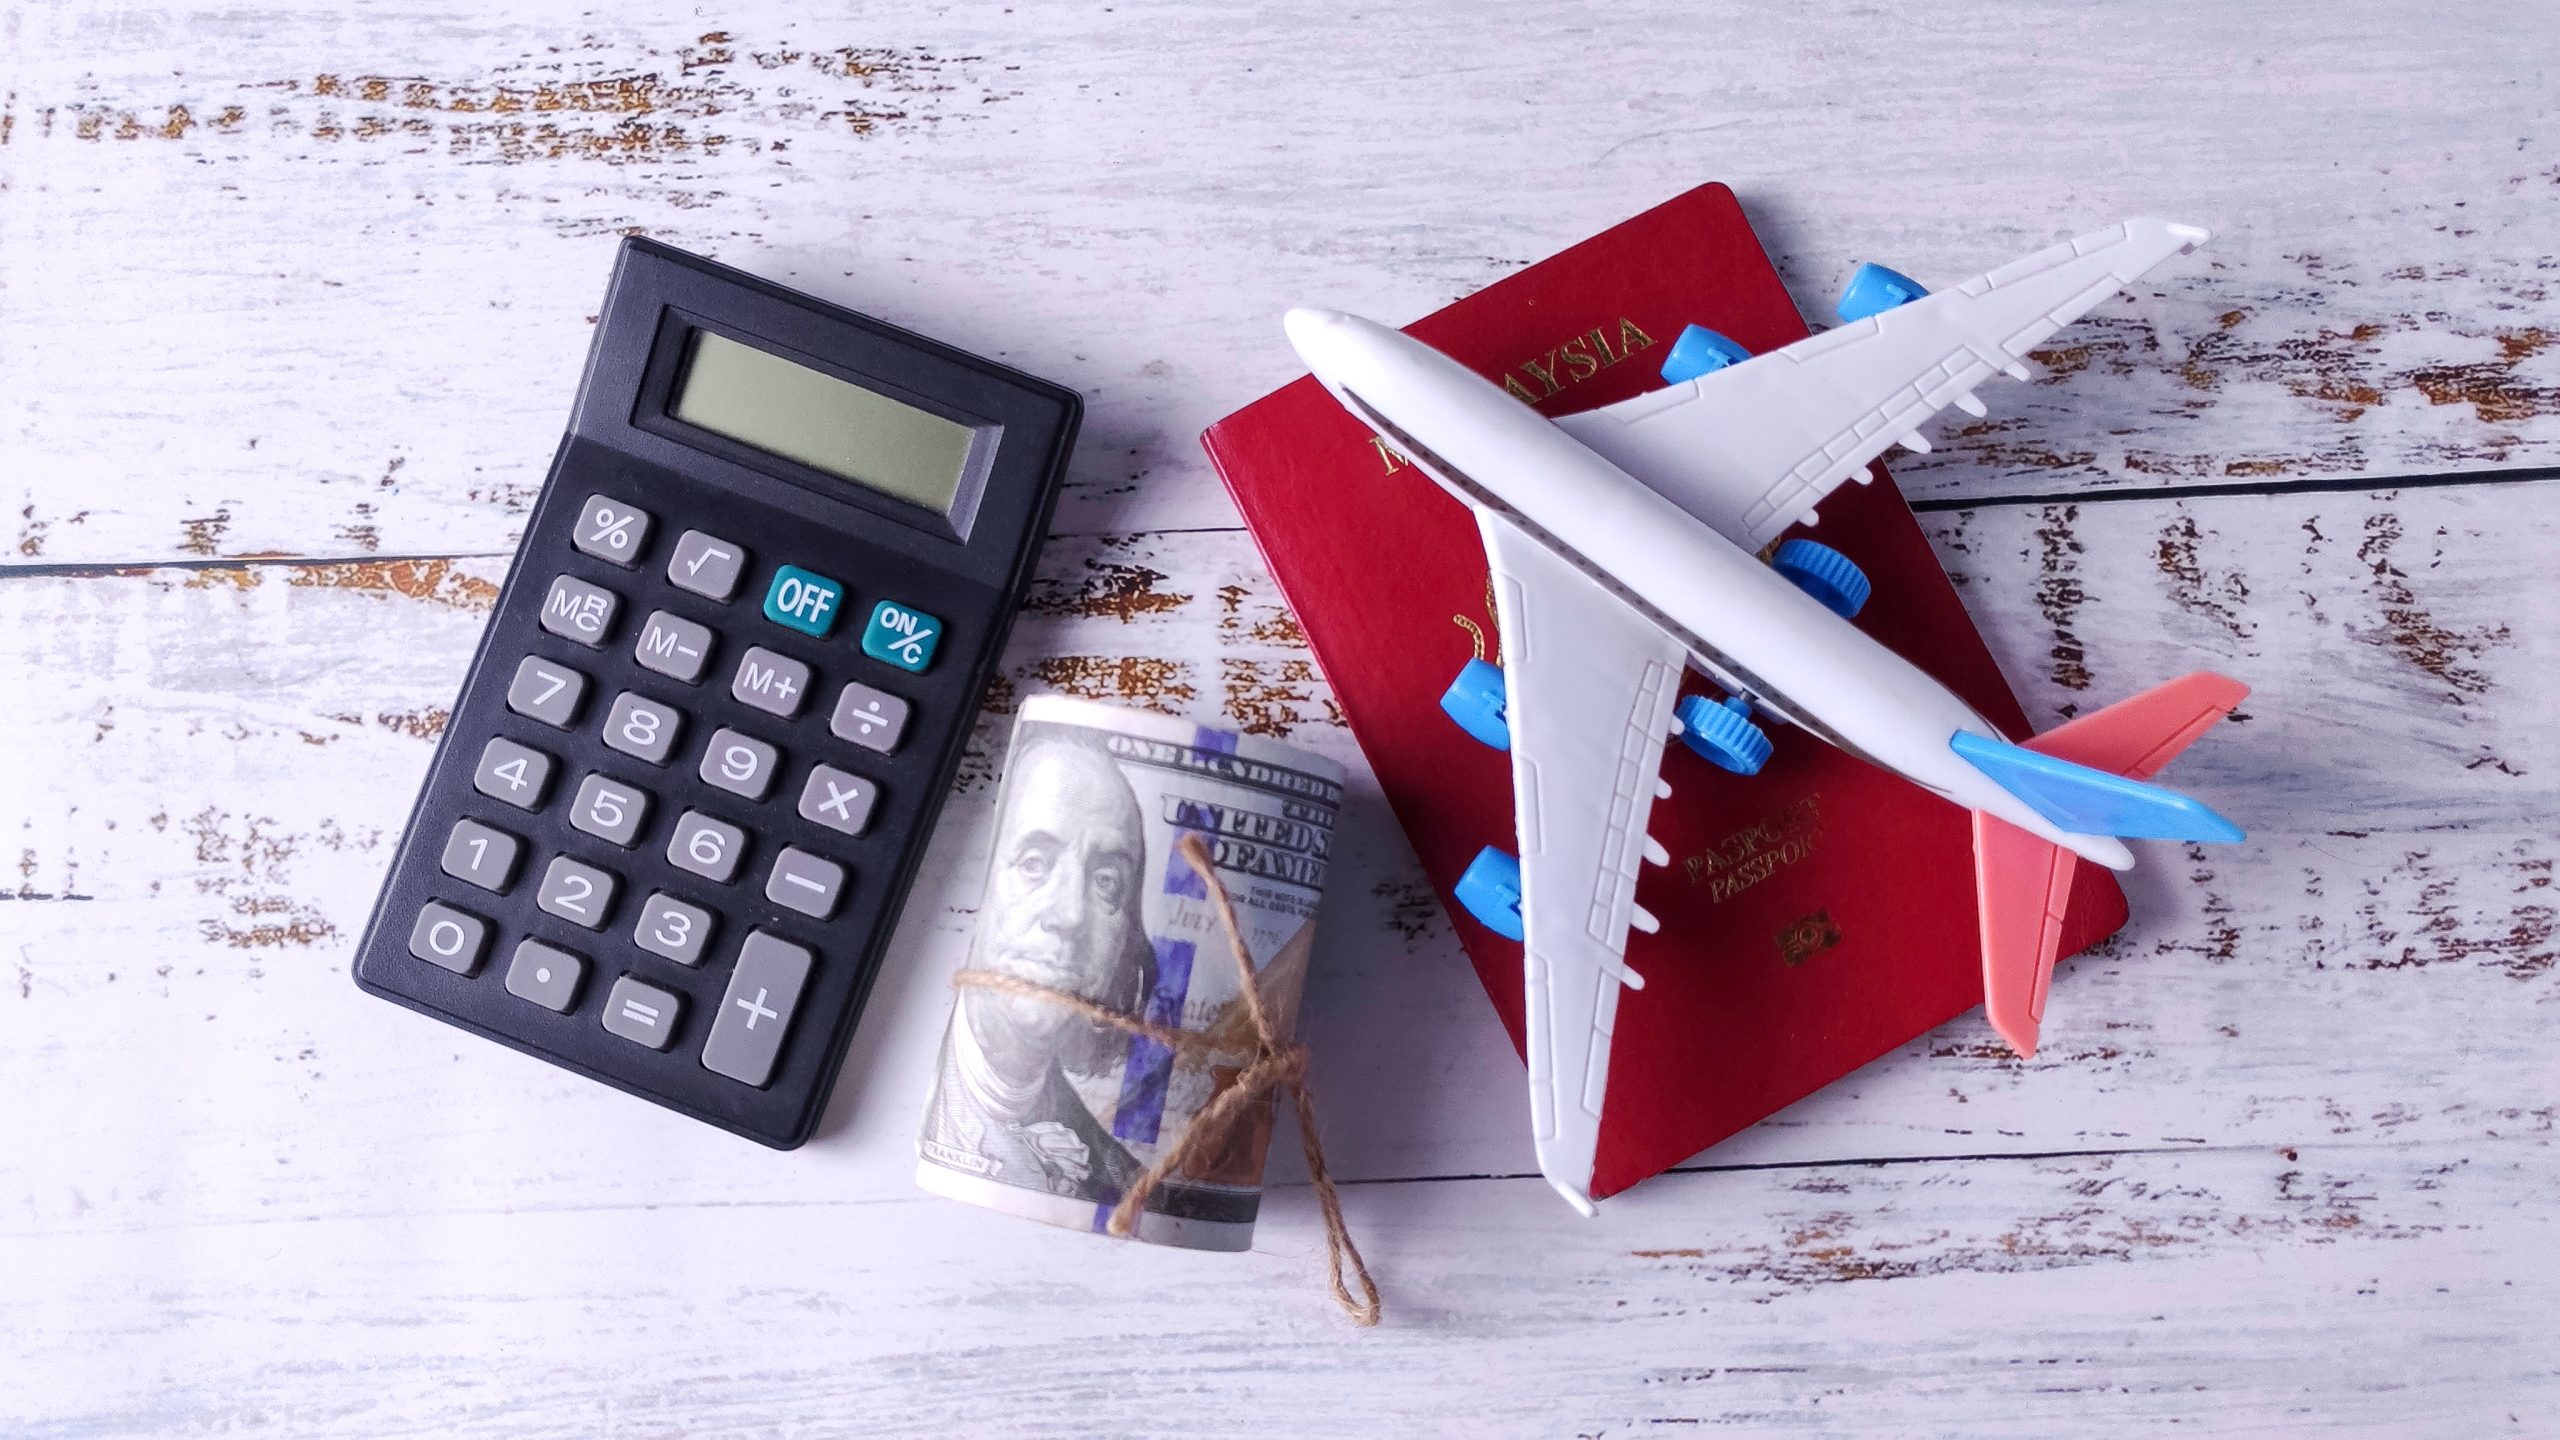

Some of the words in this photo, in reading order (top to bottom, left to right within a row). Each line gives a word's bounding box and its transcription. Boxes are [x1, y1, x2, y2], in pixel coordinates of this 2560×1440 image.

[1368, 316, 1659, 477] MAYSIA
[589, 508, 635, 549] %
[777, 577, 835, 623] OFF
[532, 670, 567, 706] 7
[743, 662, 797, 700] M+
[622, 709, 661, 746] 8
[493, 758, 528, 791] 4
[721, 745, 758, 781] 9
[590, 788, 628, 827] 5
[469, 838, 488, 871] 1
[689, 829, 726, 865] 6
[554, 875, 593, 915] 2
[654, 911, 692, 948] 3
